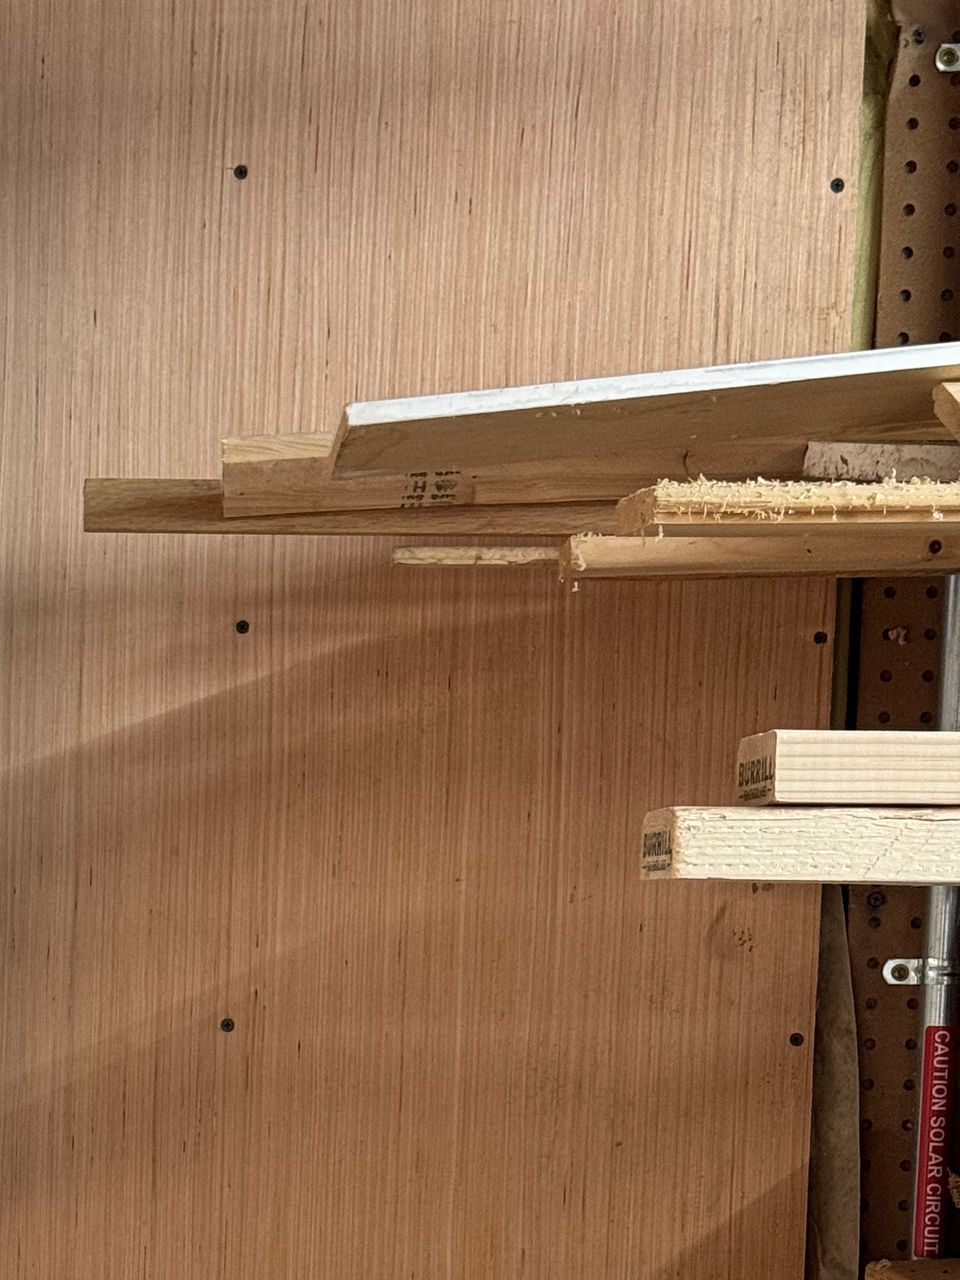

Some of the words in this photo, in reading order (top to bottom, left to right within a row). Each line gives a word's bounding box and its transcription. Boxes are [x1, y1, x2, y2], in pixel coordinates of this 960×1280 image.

[932, 1030, 951, 1111] CAUTION
[927, 1115, 946, 1178] SOLAR
[923, 1182, 942, 1256] CIRCUIT
